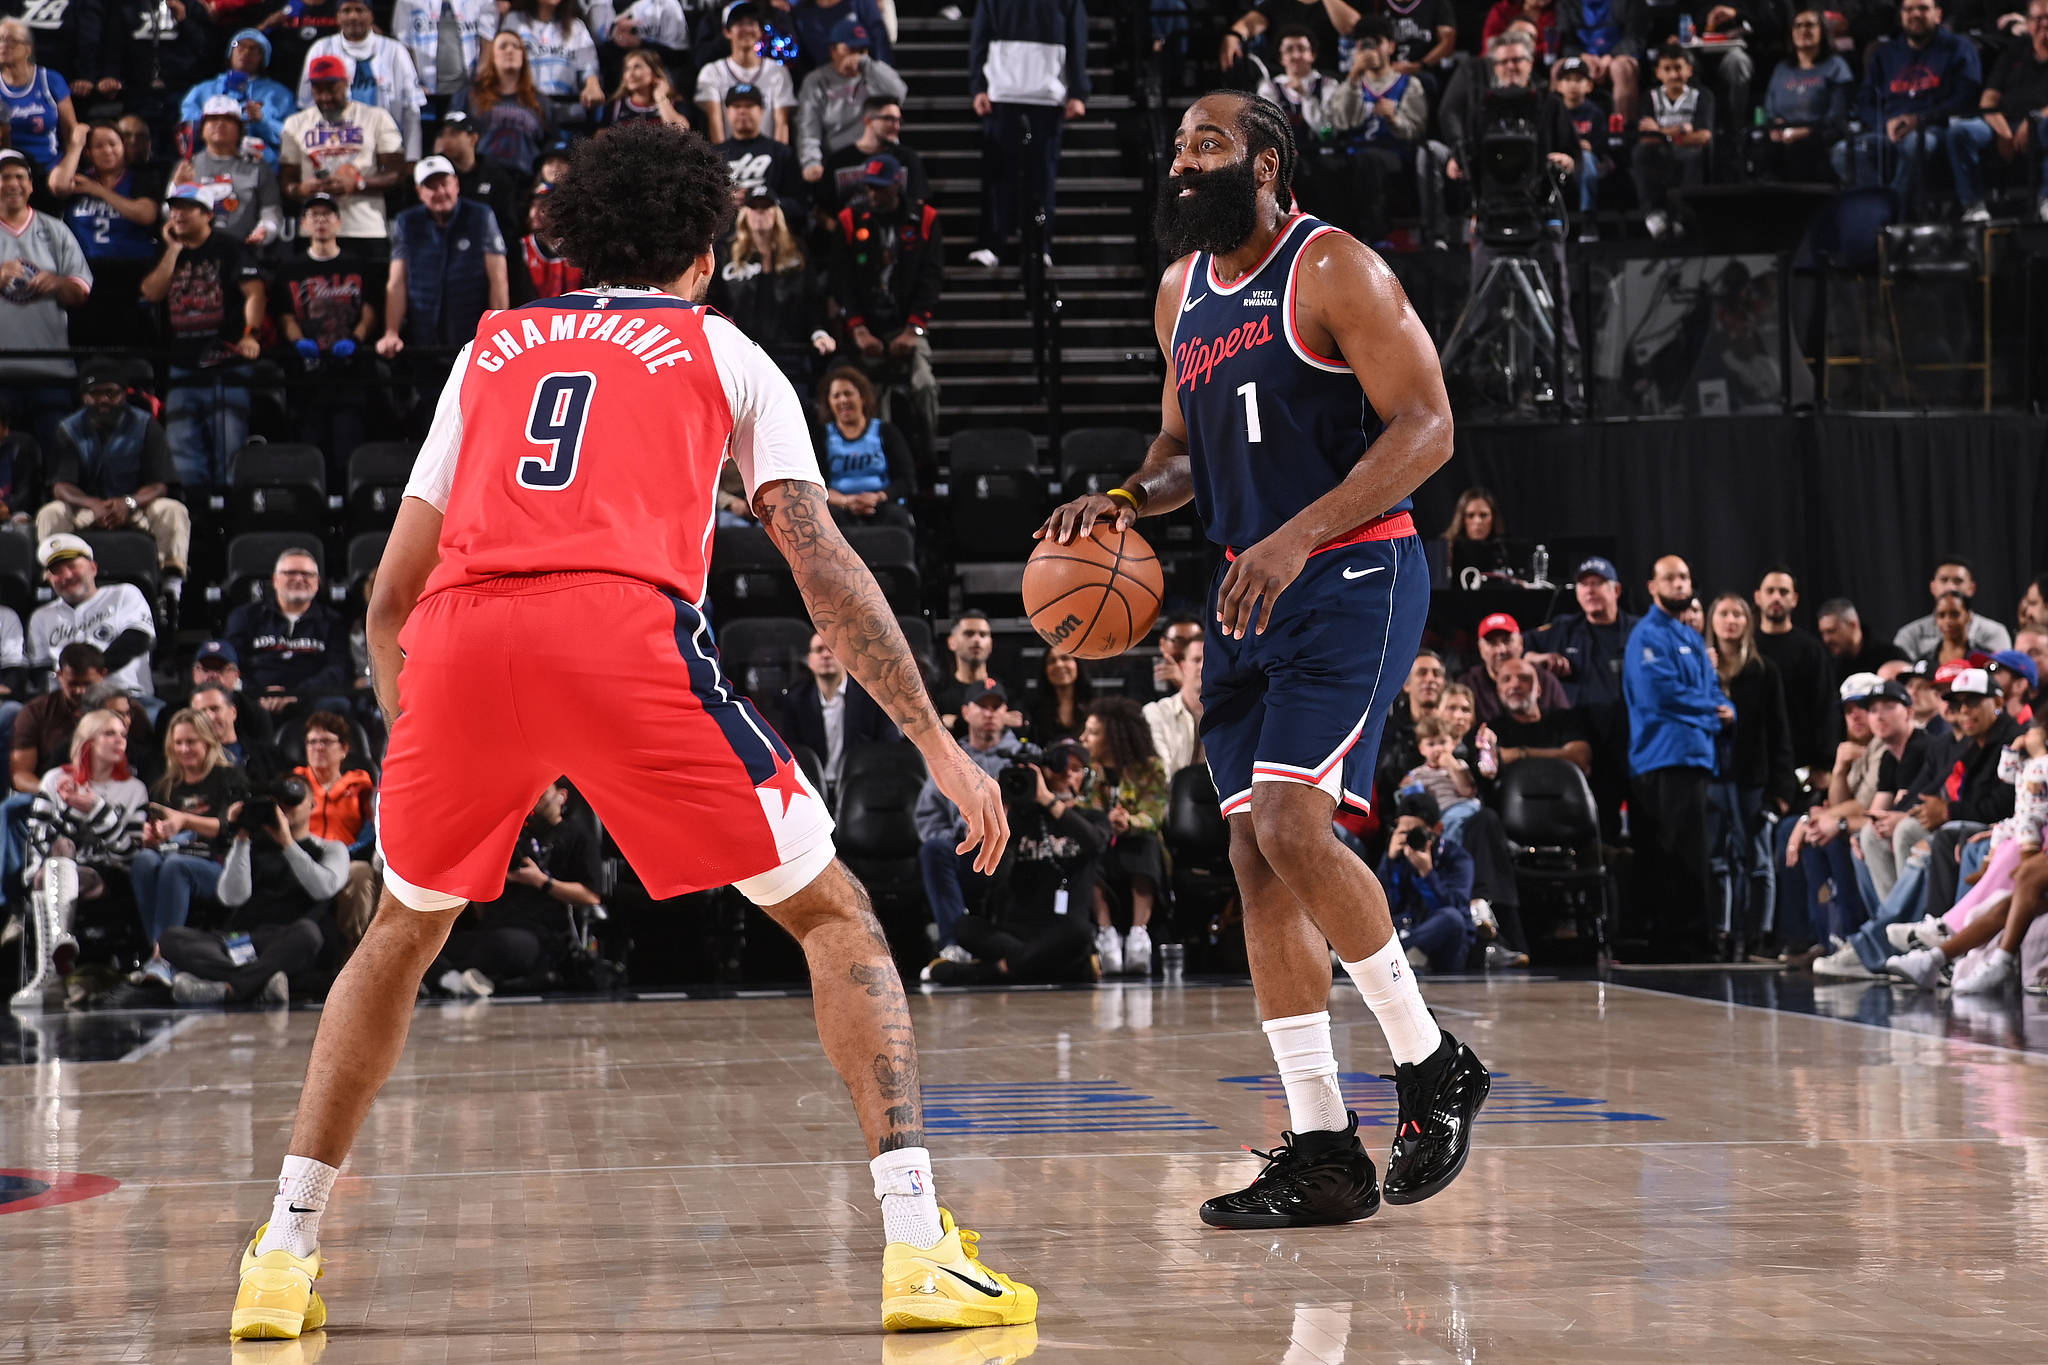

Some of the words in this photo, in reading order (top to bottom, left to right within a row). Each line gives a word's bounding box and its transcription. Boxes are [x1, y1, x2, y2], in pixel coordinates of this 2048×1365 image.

[95, 217, 111, 243] 2
[1243, 298, 1278, 307] RWANDA
[1252, 290, 1273, 299] VISIT
[476, 313, 693, 375] CHAMPAGNIE
[1174, 314, 1274, 392] Clippers
[515, 370, 598, 491] 9
[1236, 381, 1262, 443] 1
